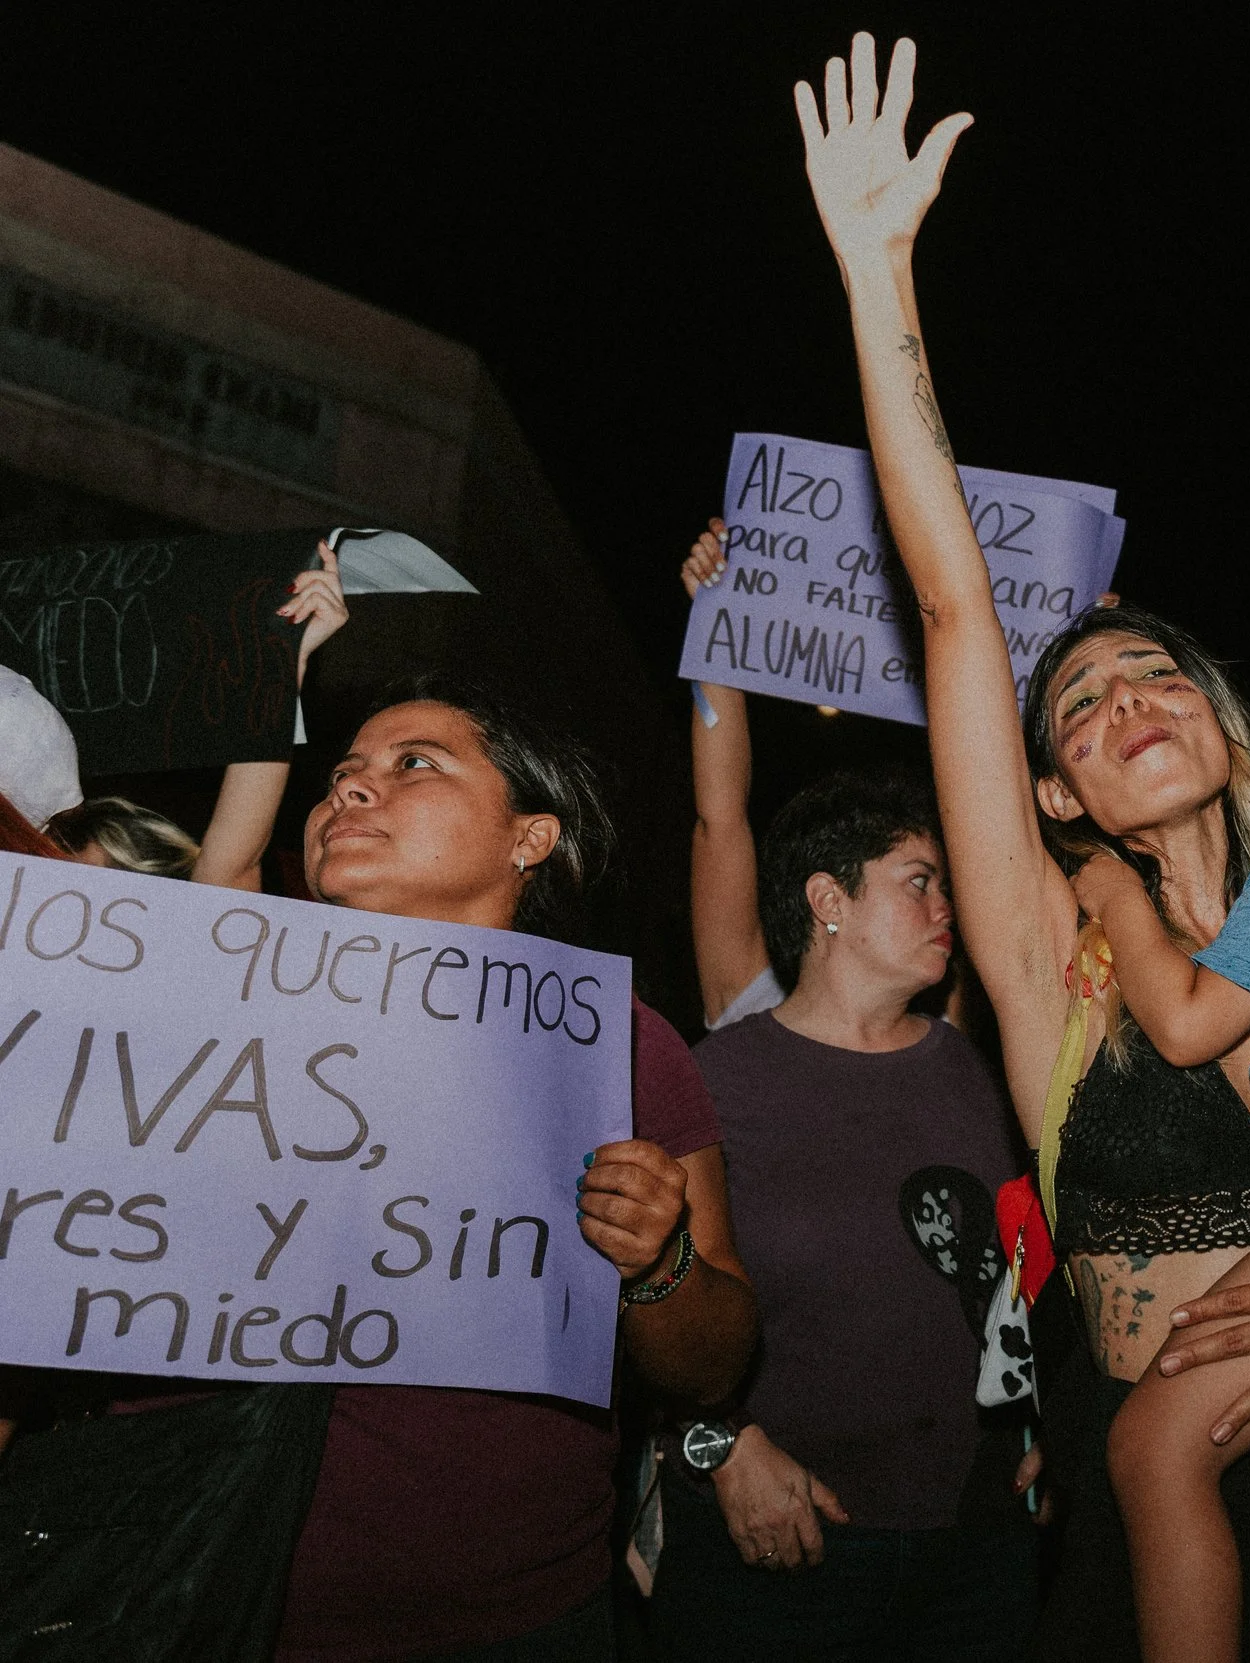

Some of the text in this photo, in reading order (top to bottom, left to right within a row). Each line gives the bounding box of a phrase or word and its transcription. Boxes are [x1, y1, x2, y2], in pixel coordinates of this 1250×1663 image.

[724, 523, 809, 564] para
[968, 493, 1035, 555] oz
[732, 566, 898, 623] NO FALTE
[704, 607, 866, 695] ALUMNA
[211, 908, 602, 1046] queremos
[64, 1284, 400, 1370] miedo
